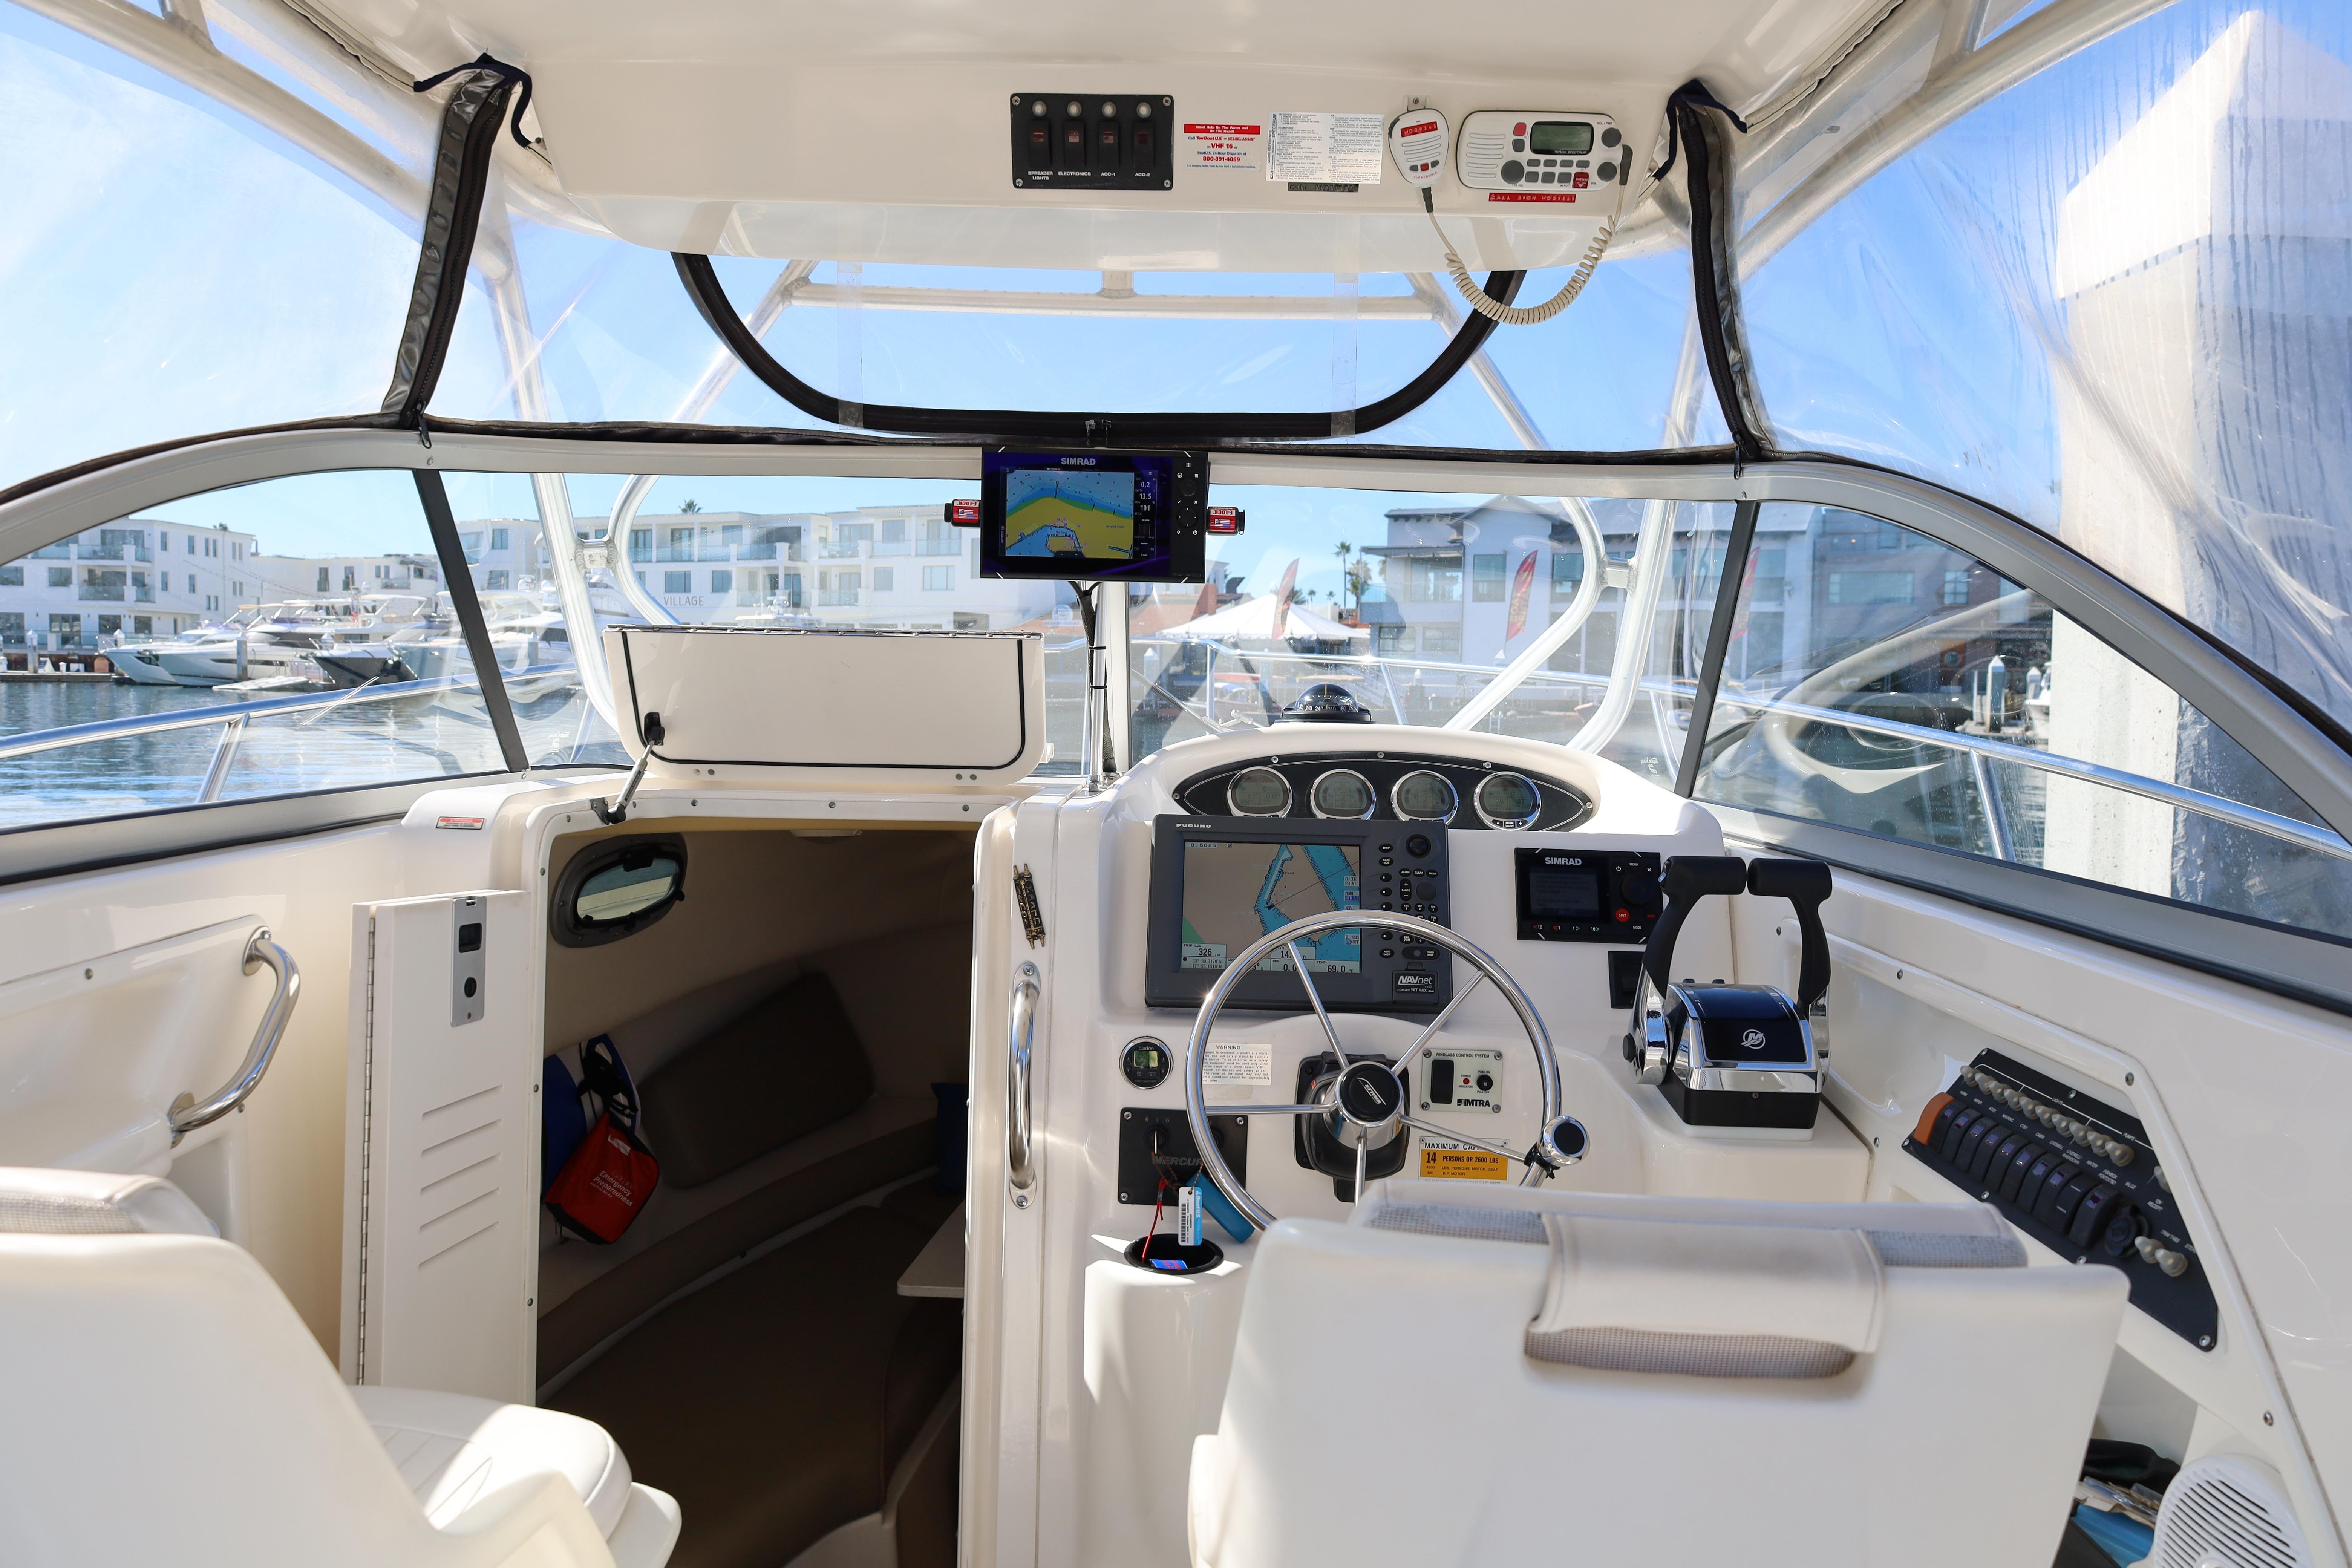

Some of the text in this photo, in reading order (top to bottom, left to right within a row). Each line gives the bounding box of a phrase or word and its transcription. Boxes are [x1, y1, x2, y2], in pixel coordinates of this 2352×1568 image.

[1413, 171, 1438, 179] SUBMERSIBLE
[1061, 457, 1096, 466] SIMRAD
[663, 596, 704, 606] VILLAGE
[1545, 857, 1582, 865] SIMRAD
[1397, 975, 1433, 985] NAVnet
[2122, 1132, 2136, 1141] PUMPS
[1152, 1156, 1204, 1167] MERCUR
[1426, 1152, 1437, 1164] 14
[599, 1170, 632, 1197] Emergency
[593, 1176, 633, 1207] Preparedness
